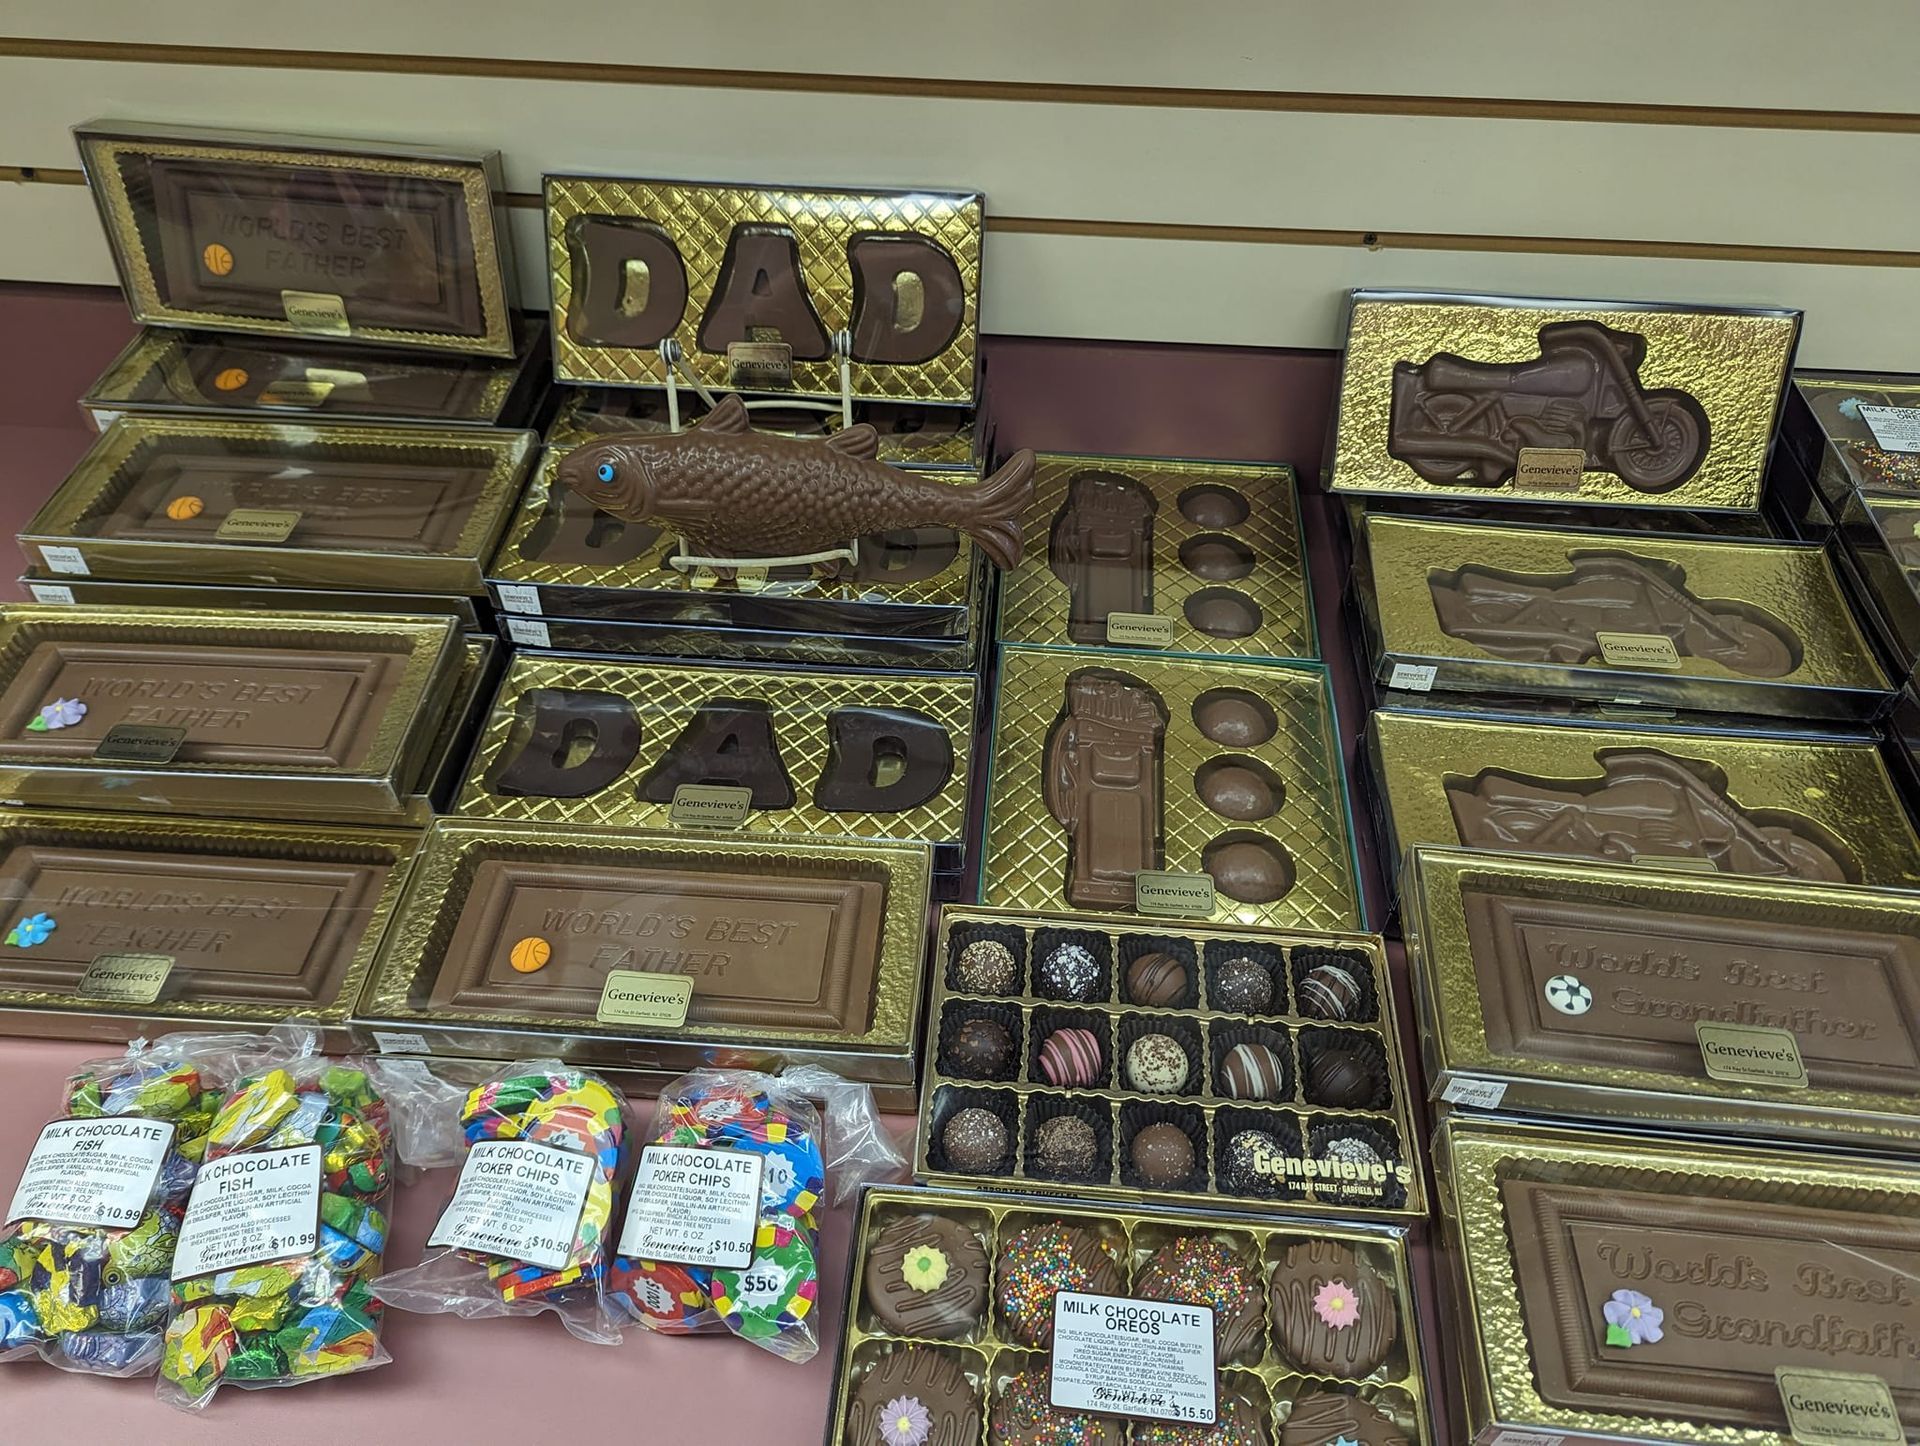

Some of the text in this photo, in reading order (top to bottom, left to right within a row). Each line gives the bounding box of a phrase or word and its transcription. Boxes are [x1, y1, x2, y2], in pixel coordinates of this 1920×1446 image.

[216, 211, 407, 251] WORLD'S BEST
[265, 251, 367, 279] FATHER
[565, 214, 966, 366] DAD
[289, 304, 342, 323] Genevieve's
[731, 358, 789, 371] Genevieve's
[1520, 463, 1579, 477] Genevieve's
[227, 517, 290, 529] Genevieve's
[1110, 621, 1170, 634] Genevieve's
[1604, 641, 1672, 656] Genevieve's
[80, 676, 321, 704] WORLD'S BEST
[124, 705, 251, 729] FATHER
[107, 733, 177, 747] Genevieve's
[482, 687, 955, 813] DAD
[676, 796, 746, 811] Genevieve's
[1140, 884, 1210, 898] Genevieve's
[56, 885, 293, 920] WORLD'S BEST
[541, 908, 800, 946] WORLD'S BEST
[74, 921, 232, 953] TEACHER
[590, 944, 732, 977] FATHER
[89, 968, 161, 984] Genevieve's
[1722, 959, 1828, 995] Best
[608, 989, 684, 1005] Genevieve's
[1706, 1041, 1794, 1062] Genevieve's
[44, 1124, 162, 1141] MILK CHOCOLATE
[72, 1140, 104, 1151] FISH
[214, 1154, 311, 1179] CHOCOLATE
[473, 1147, 584, 1175] MILK CHOCOLATE
[646, 1152, 752, 1173] MILK CHOCOLATE
[1254, 1150, 1411, 1184] Genevieve's
[475, 1162, 559, 1186] POKER CHIPS
[652, 1169, 731, 1188] POKER CHIPS
[767, 1166, 789, 1184] 10
[219, 1177, 253, 1194] FISH
[554, 1189, 577, 1199] COCOA
[1288, 1181, 1301, 1191] 174
[1315, 1183, 1338, 1192] STREET
[97, 1205, 141, 1220] $10.99
[649, 1226, 664, 1235] NET
[683, 1230, 688, 1238] 6
[271, 1233, 315, 1250] $10.99
[532, 1235, 570, 1253] $10.50
[714, 1240, 753, 1253] $10.50
[744, 1273, 778, 1294] $50
[1598, 1245, 1915, 1306] World's Best
[1063, 1300, 1201, 1327] MILK CHOCOLATE
[1105, 1318, 1160, 1335] OREOS
[1173, 1407, 1213, 1420] $15.50
[1790, 1394, 1891, 1418] Genevieve's
